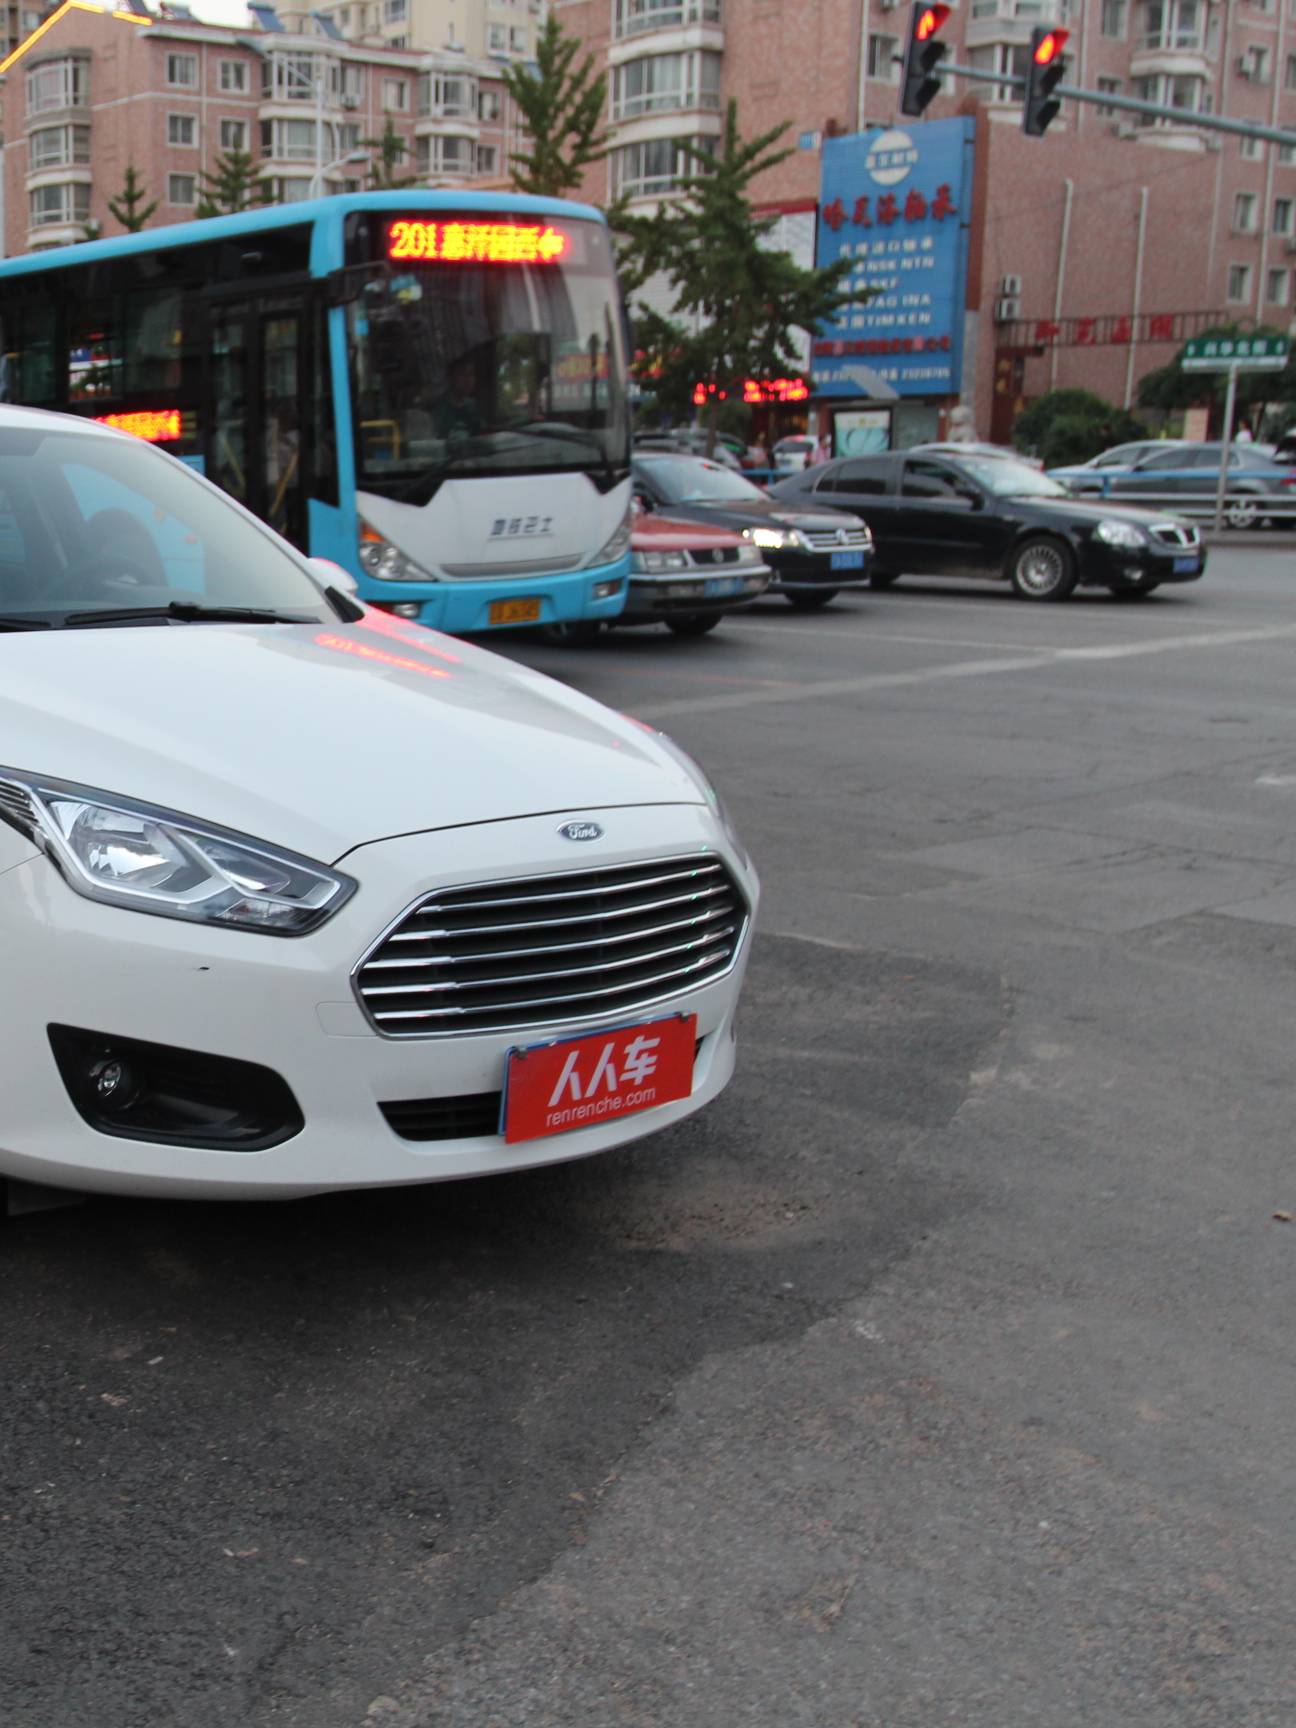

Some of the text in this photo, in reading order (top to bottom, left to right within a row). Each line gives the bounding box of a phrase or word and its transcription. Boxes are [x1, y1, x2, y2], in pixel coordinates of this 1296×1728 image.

[390, 221, 439, 258] 201
[567, 823, 598, 839] Ford
[547, 1035, 661, 1107] 人人车
[546, 1087, 657, 1128] renrenche.com
